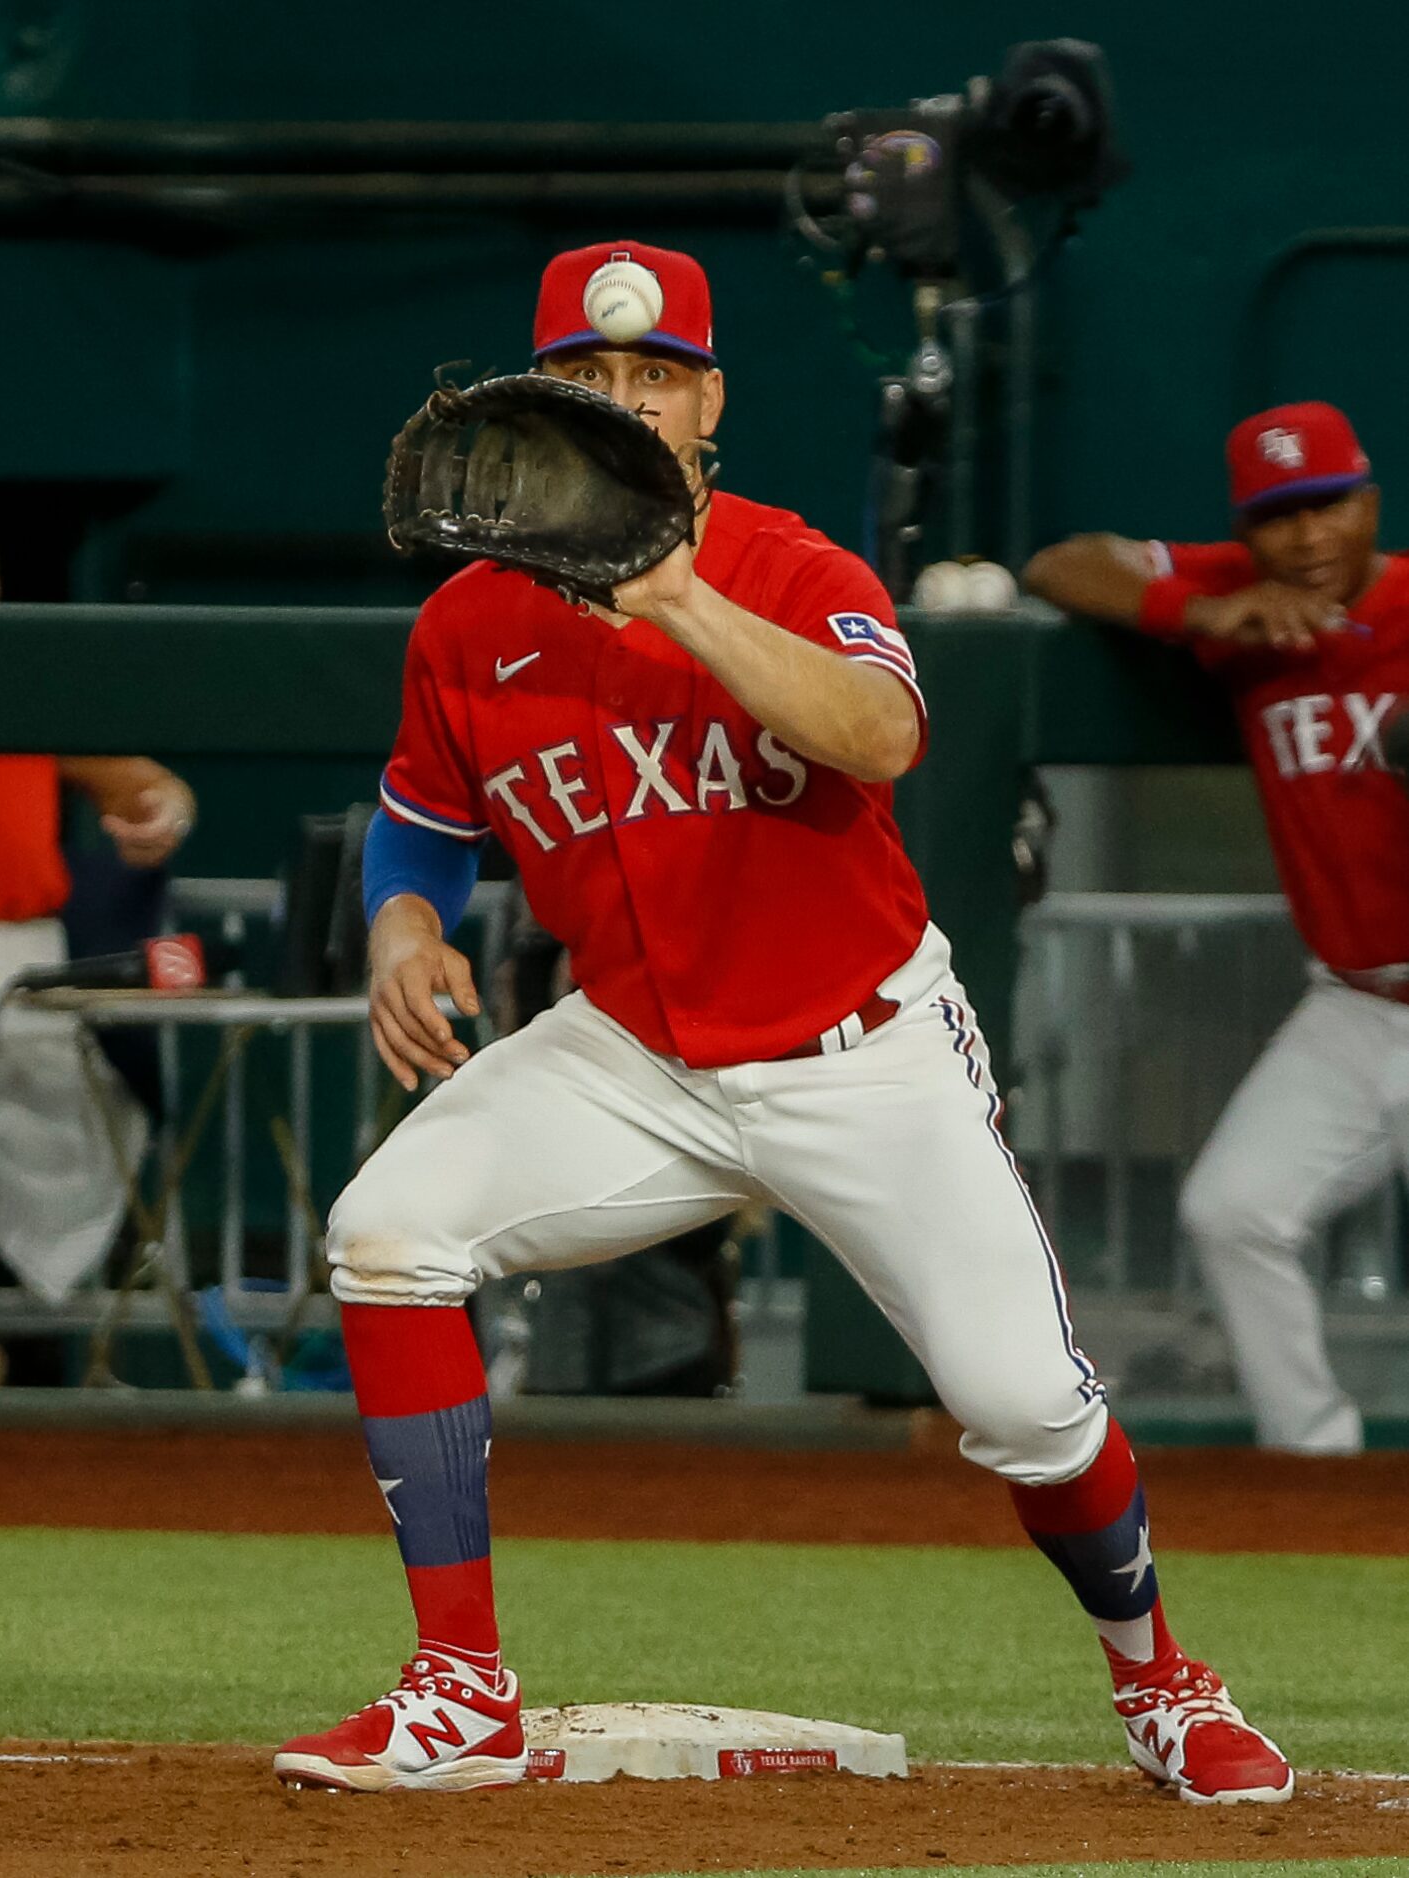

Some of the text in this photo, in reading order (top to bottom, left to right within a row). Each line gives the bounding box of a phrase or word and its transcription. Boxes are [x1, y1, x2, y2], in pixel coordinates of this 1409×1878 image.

[484, 722, 808, 851] TEXAS
[405, 1708, 467, 1760] N
[761, 1755, 787, 1766] TEXAS
